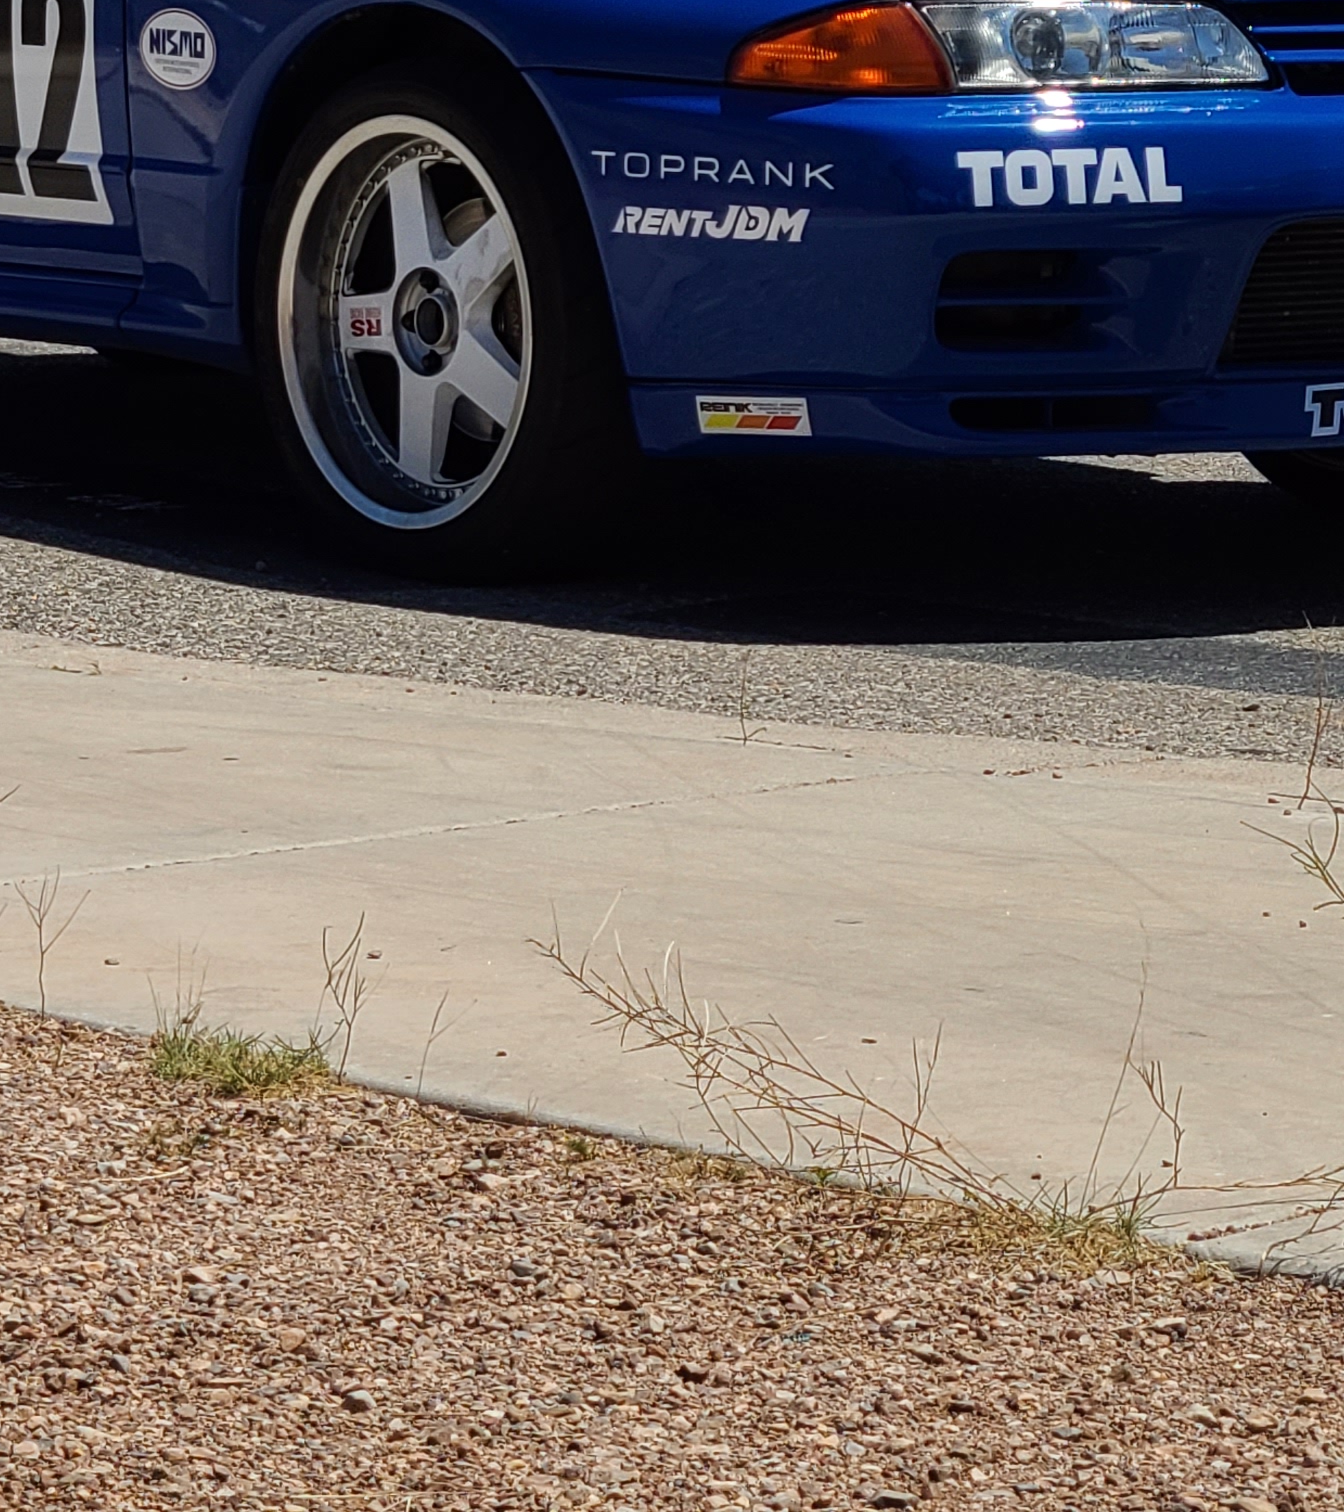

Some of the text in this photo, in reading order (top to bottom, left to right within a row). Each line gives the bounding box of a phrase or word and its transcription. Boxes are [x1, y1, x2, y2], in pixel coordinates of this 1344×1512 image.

[149, 27, 206, 60] NISMO
[591, 149, 836, 191] TOPRANK
[955, 145, 1184, 208] TOTAL
